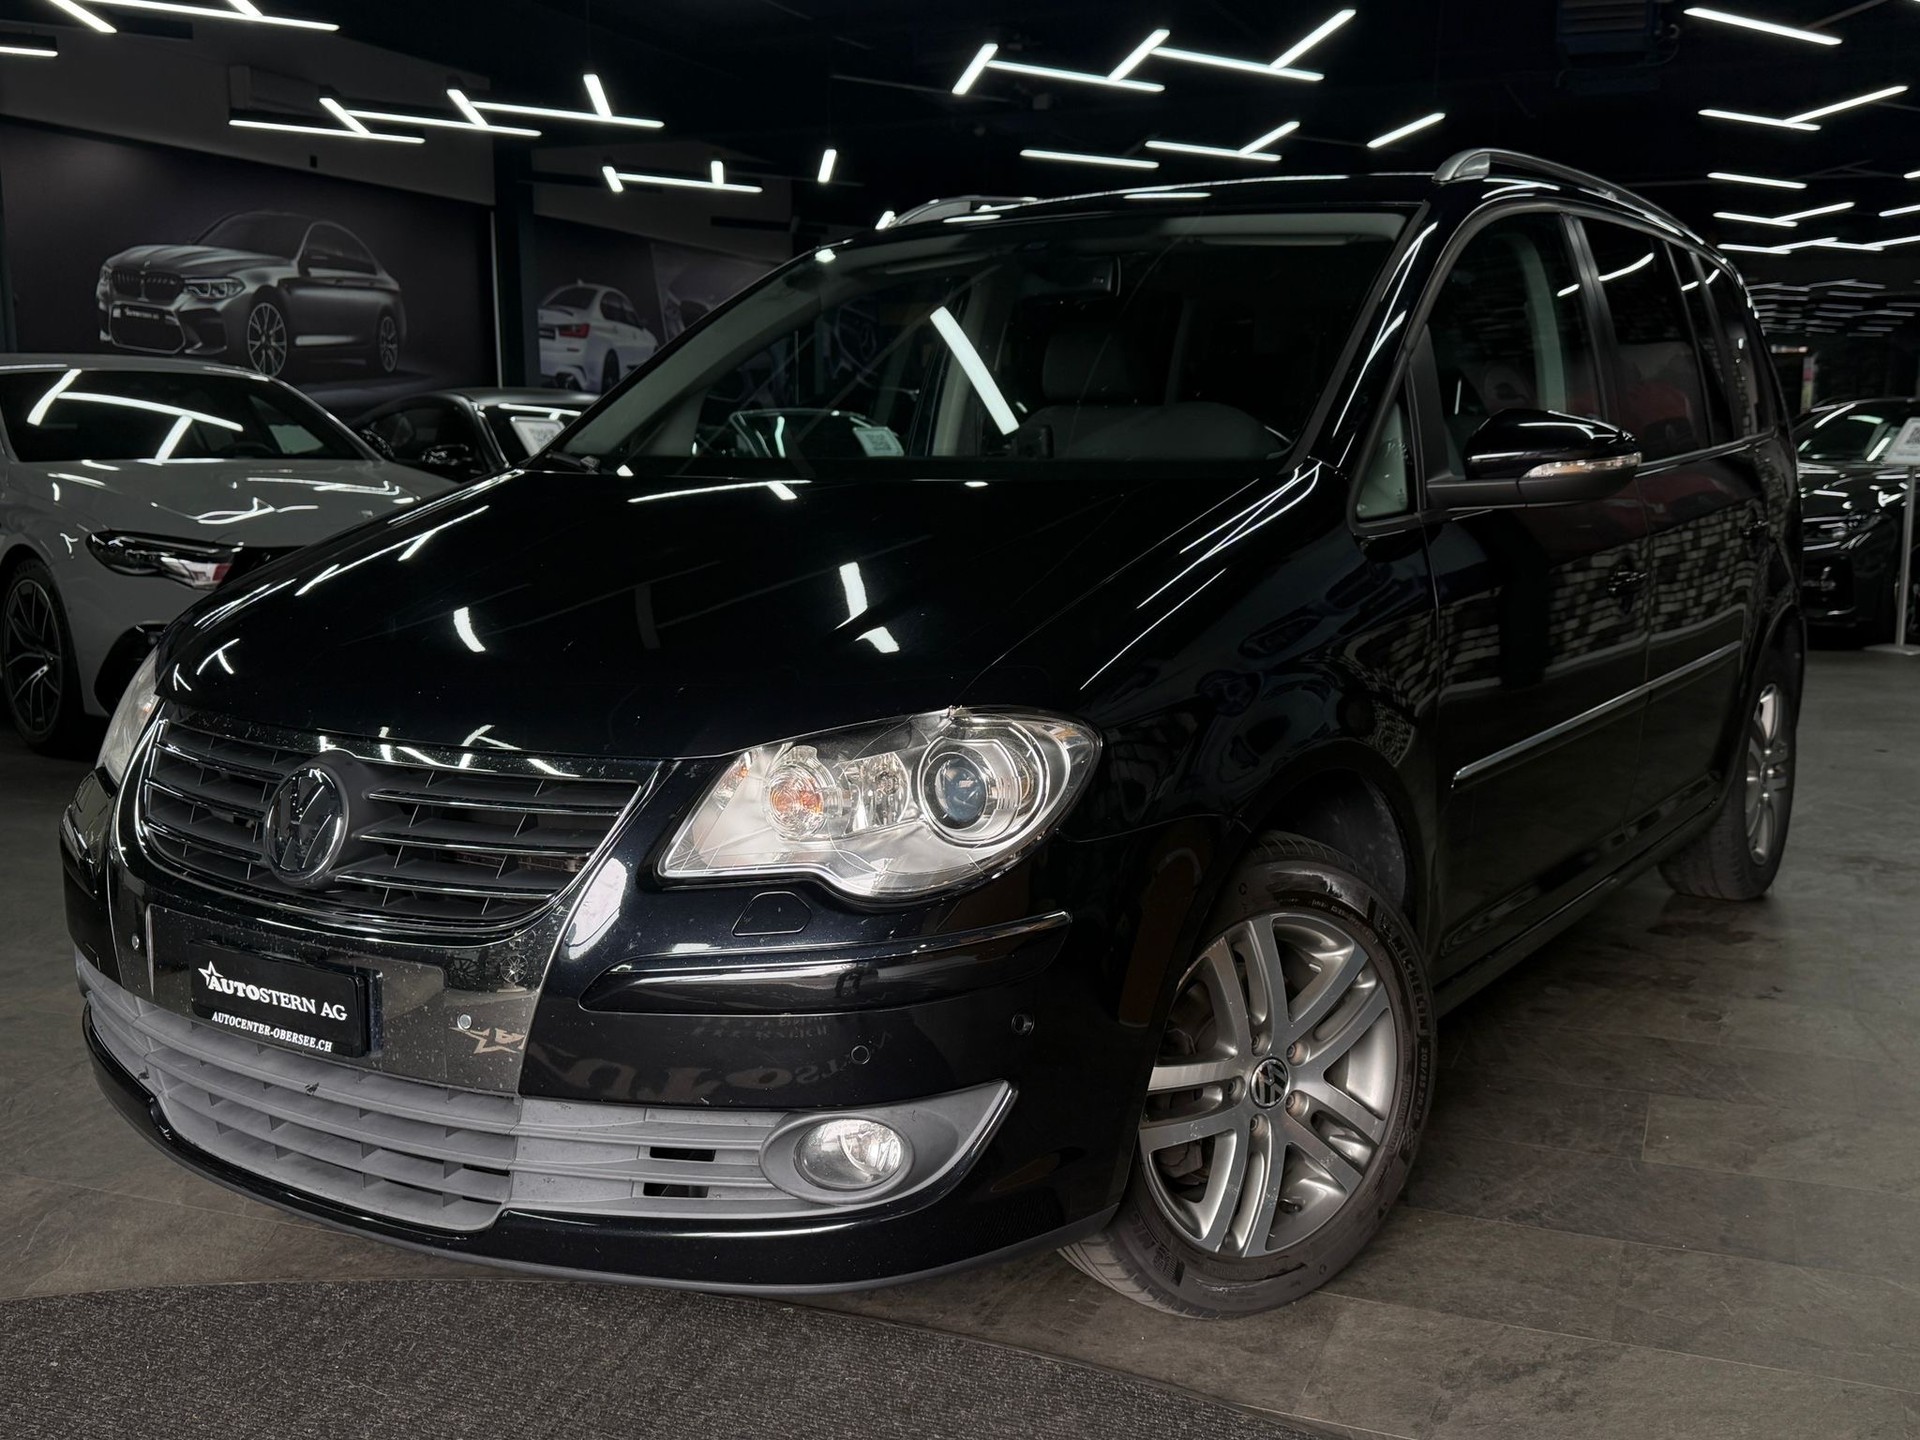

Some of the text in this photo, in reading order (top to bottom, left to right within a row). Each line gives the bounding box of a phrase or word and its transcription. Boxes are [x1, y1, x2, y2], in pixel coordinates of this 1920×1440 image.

[208, 976, 348, 1021] AUTOSTERN AG
[1393, 936, 1428, 1036] MICHELIN
[212, 1011, 333, 1052] AUTOCENTER-OBERSEE.CH
